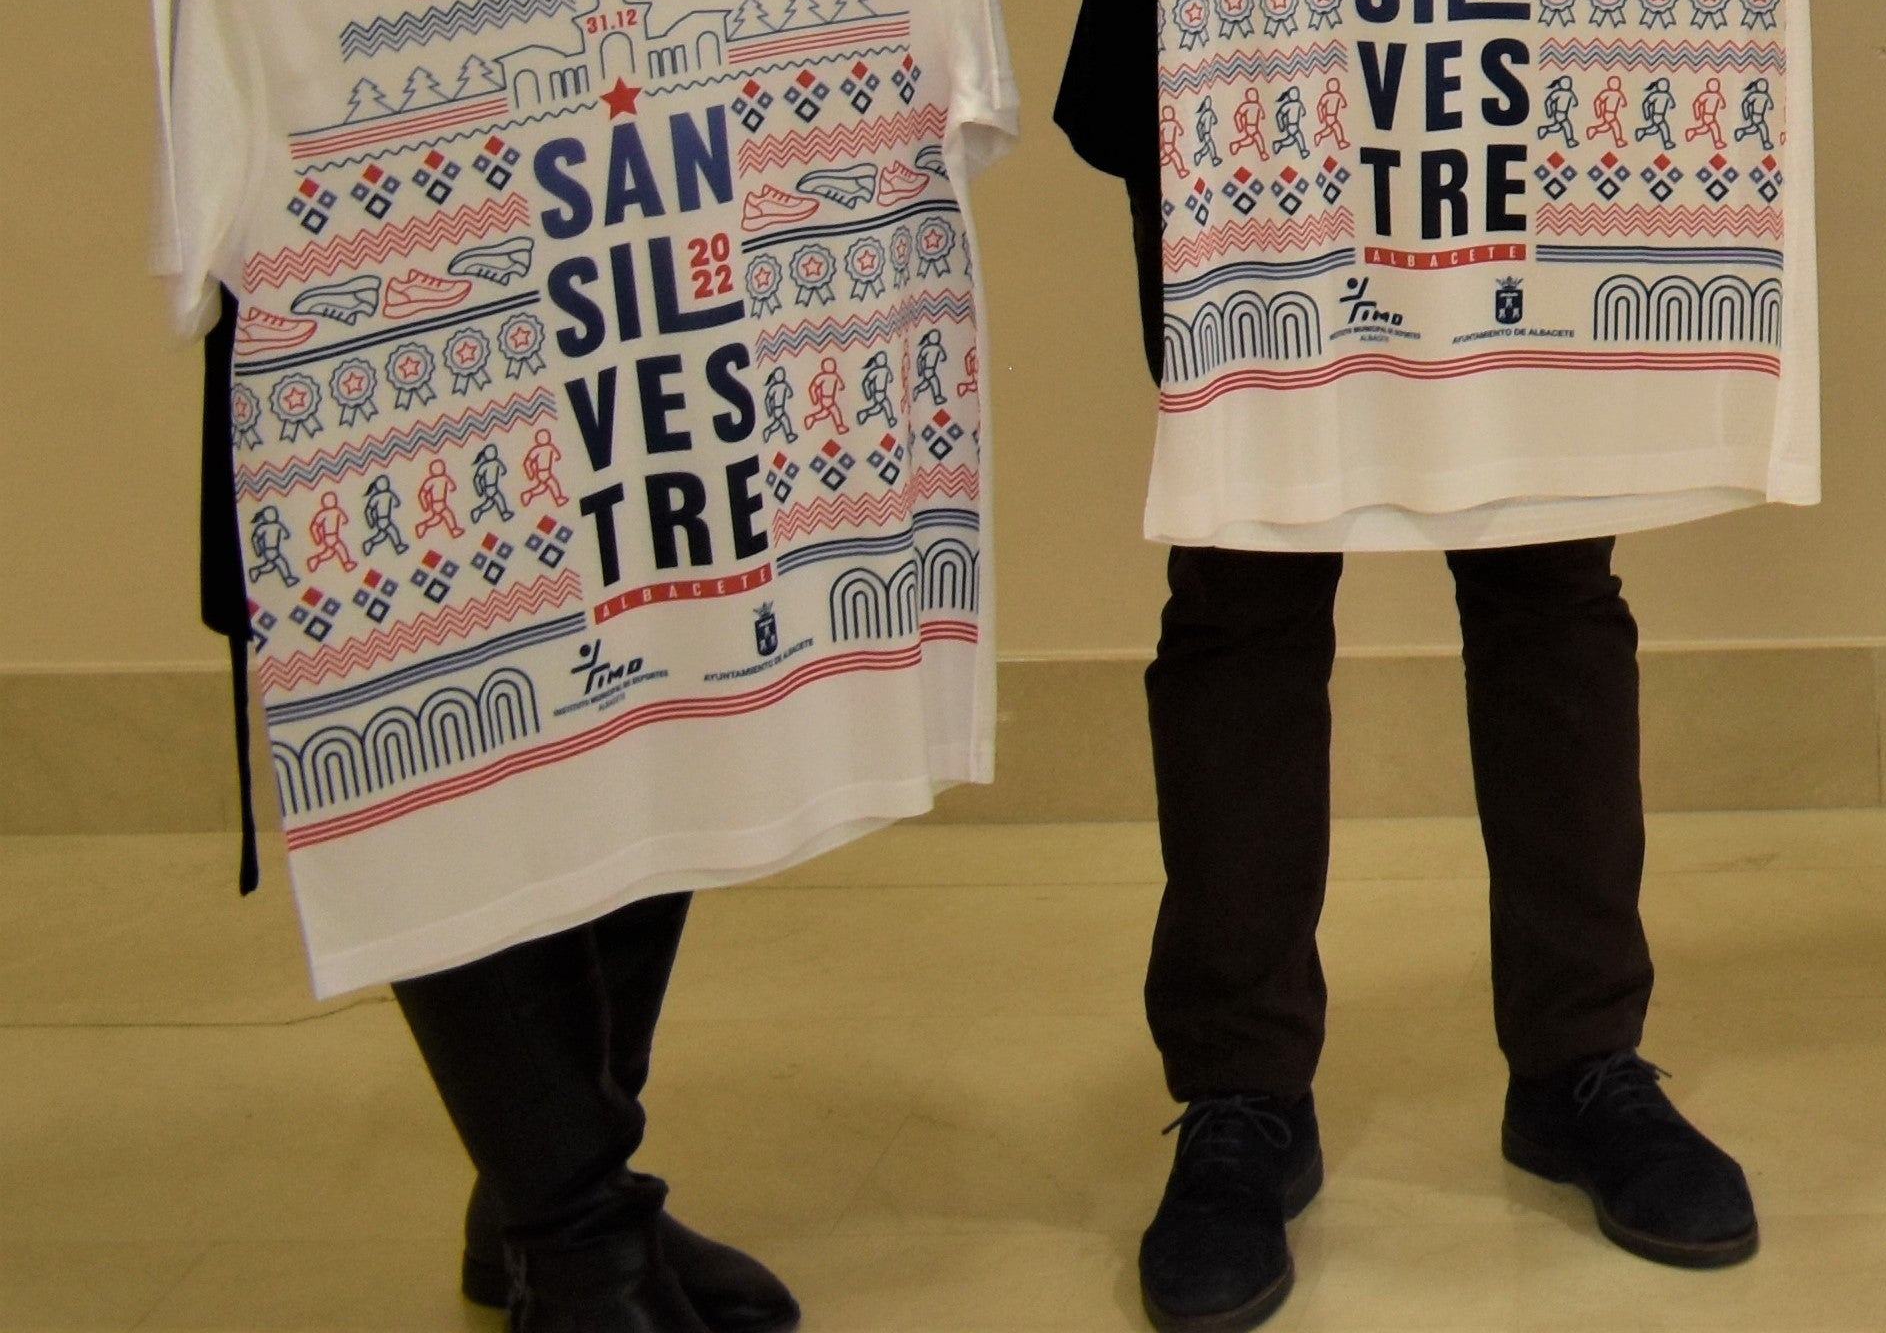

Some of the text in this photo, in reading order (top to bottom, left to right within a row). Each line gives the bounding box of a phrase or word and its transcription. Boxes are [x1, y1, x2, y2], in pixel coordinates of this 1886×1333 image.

[586, 9, 638, 35] 31.12
[1357, 37, 1530, 131] VES
[532, 104, 733, 241] SAN
[1360, 143, 1528, 240] TRE
[688, 233, 730, 266] 20
[692, 267, 734, 301] 22
[1373, 246, 1516, 267] ALBACETE
[545, 236, 744, 360] SIL
[1452, 329, 1575, 345] AYUNTAMIENTO DE ALBACETE
[565, 340, 757, 473] VES
[580, 454, 770, 588] TRE
[603, 568, 767, 618] ALBACETE
